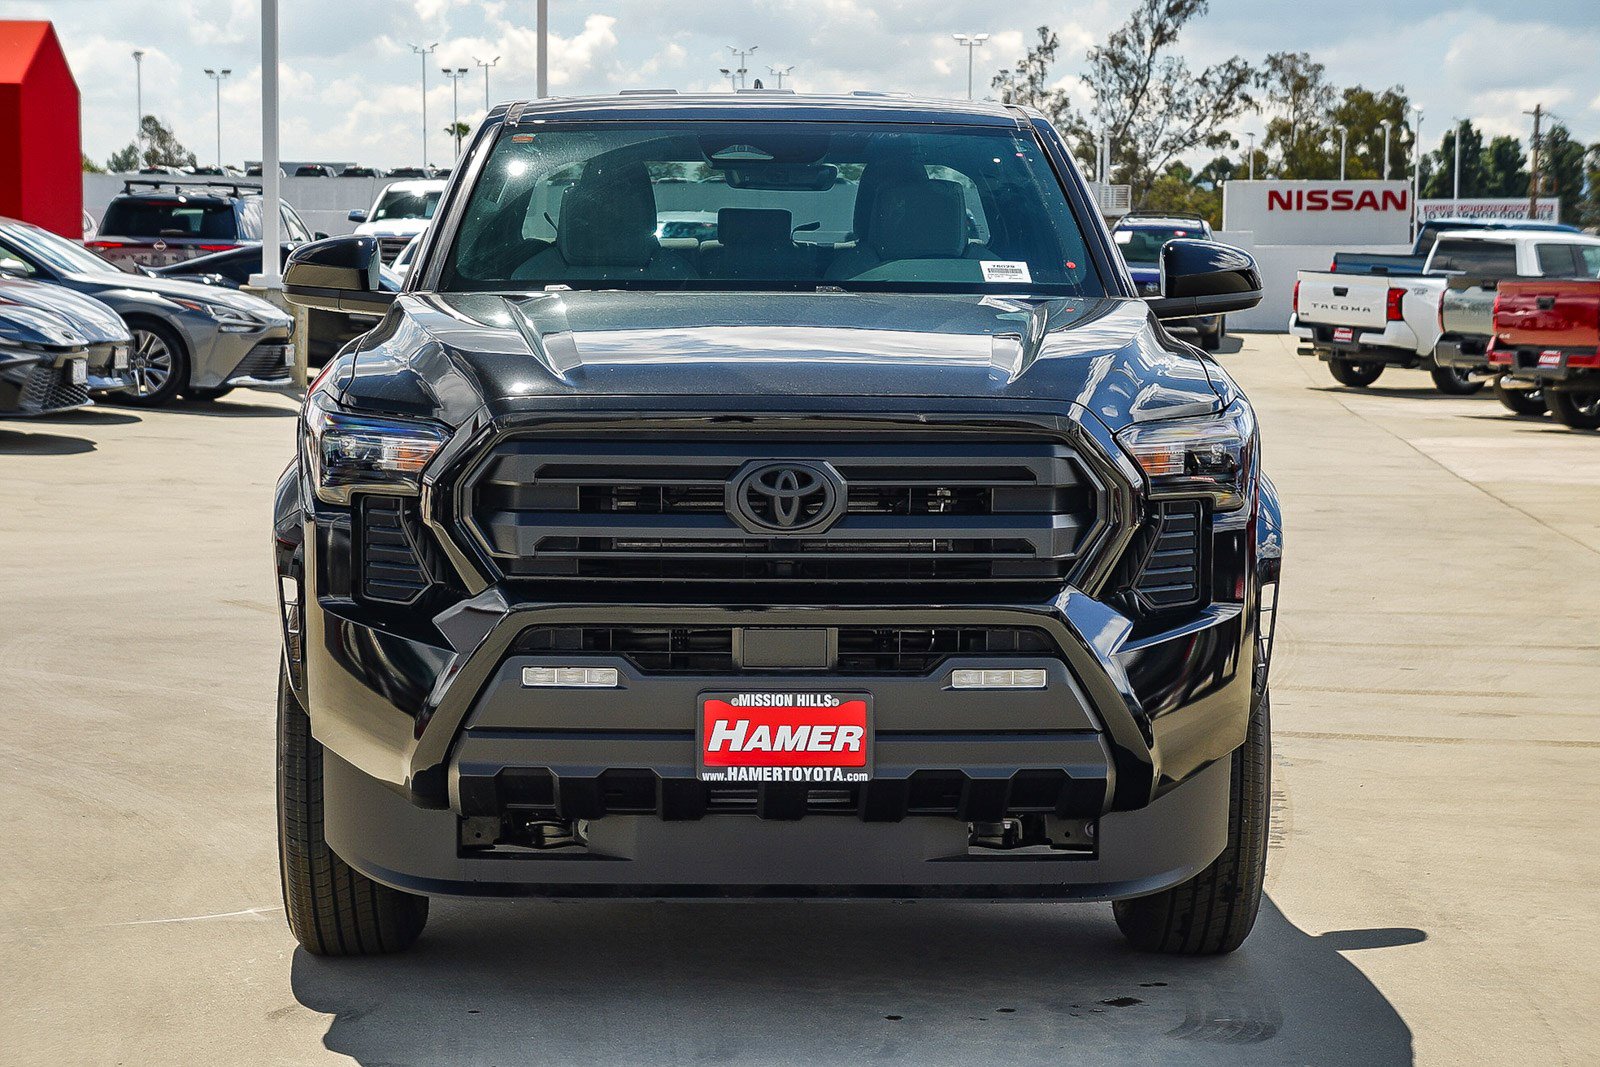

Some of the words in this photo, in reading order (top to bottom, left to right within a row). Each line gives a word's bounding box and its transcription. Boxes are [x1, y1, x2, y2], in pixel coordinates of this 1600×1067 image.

[1268, 190, 1407, 211] NISSAN
[110, 254, 190, 262] PATHFIND
[1311, 303, 1371, 312] TACOMA
[738, 693, 793, 707] MISSION
[796, 693, 832, 707] HILLS
[707, 719, 864, 752] HAMER
[702, 766, 868, 782] www.HAMERTOYOTA.com
